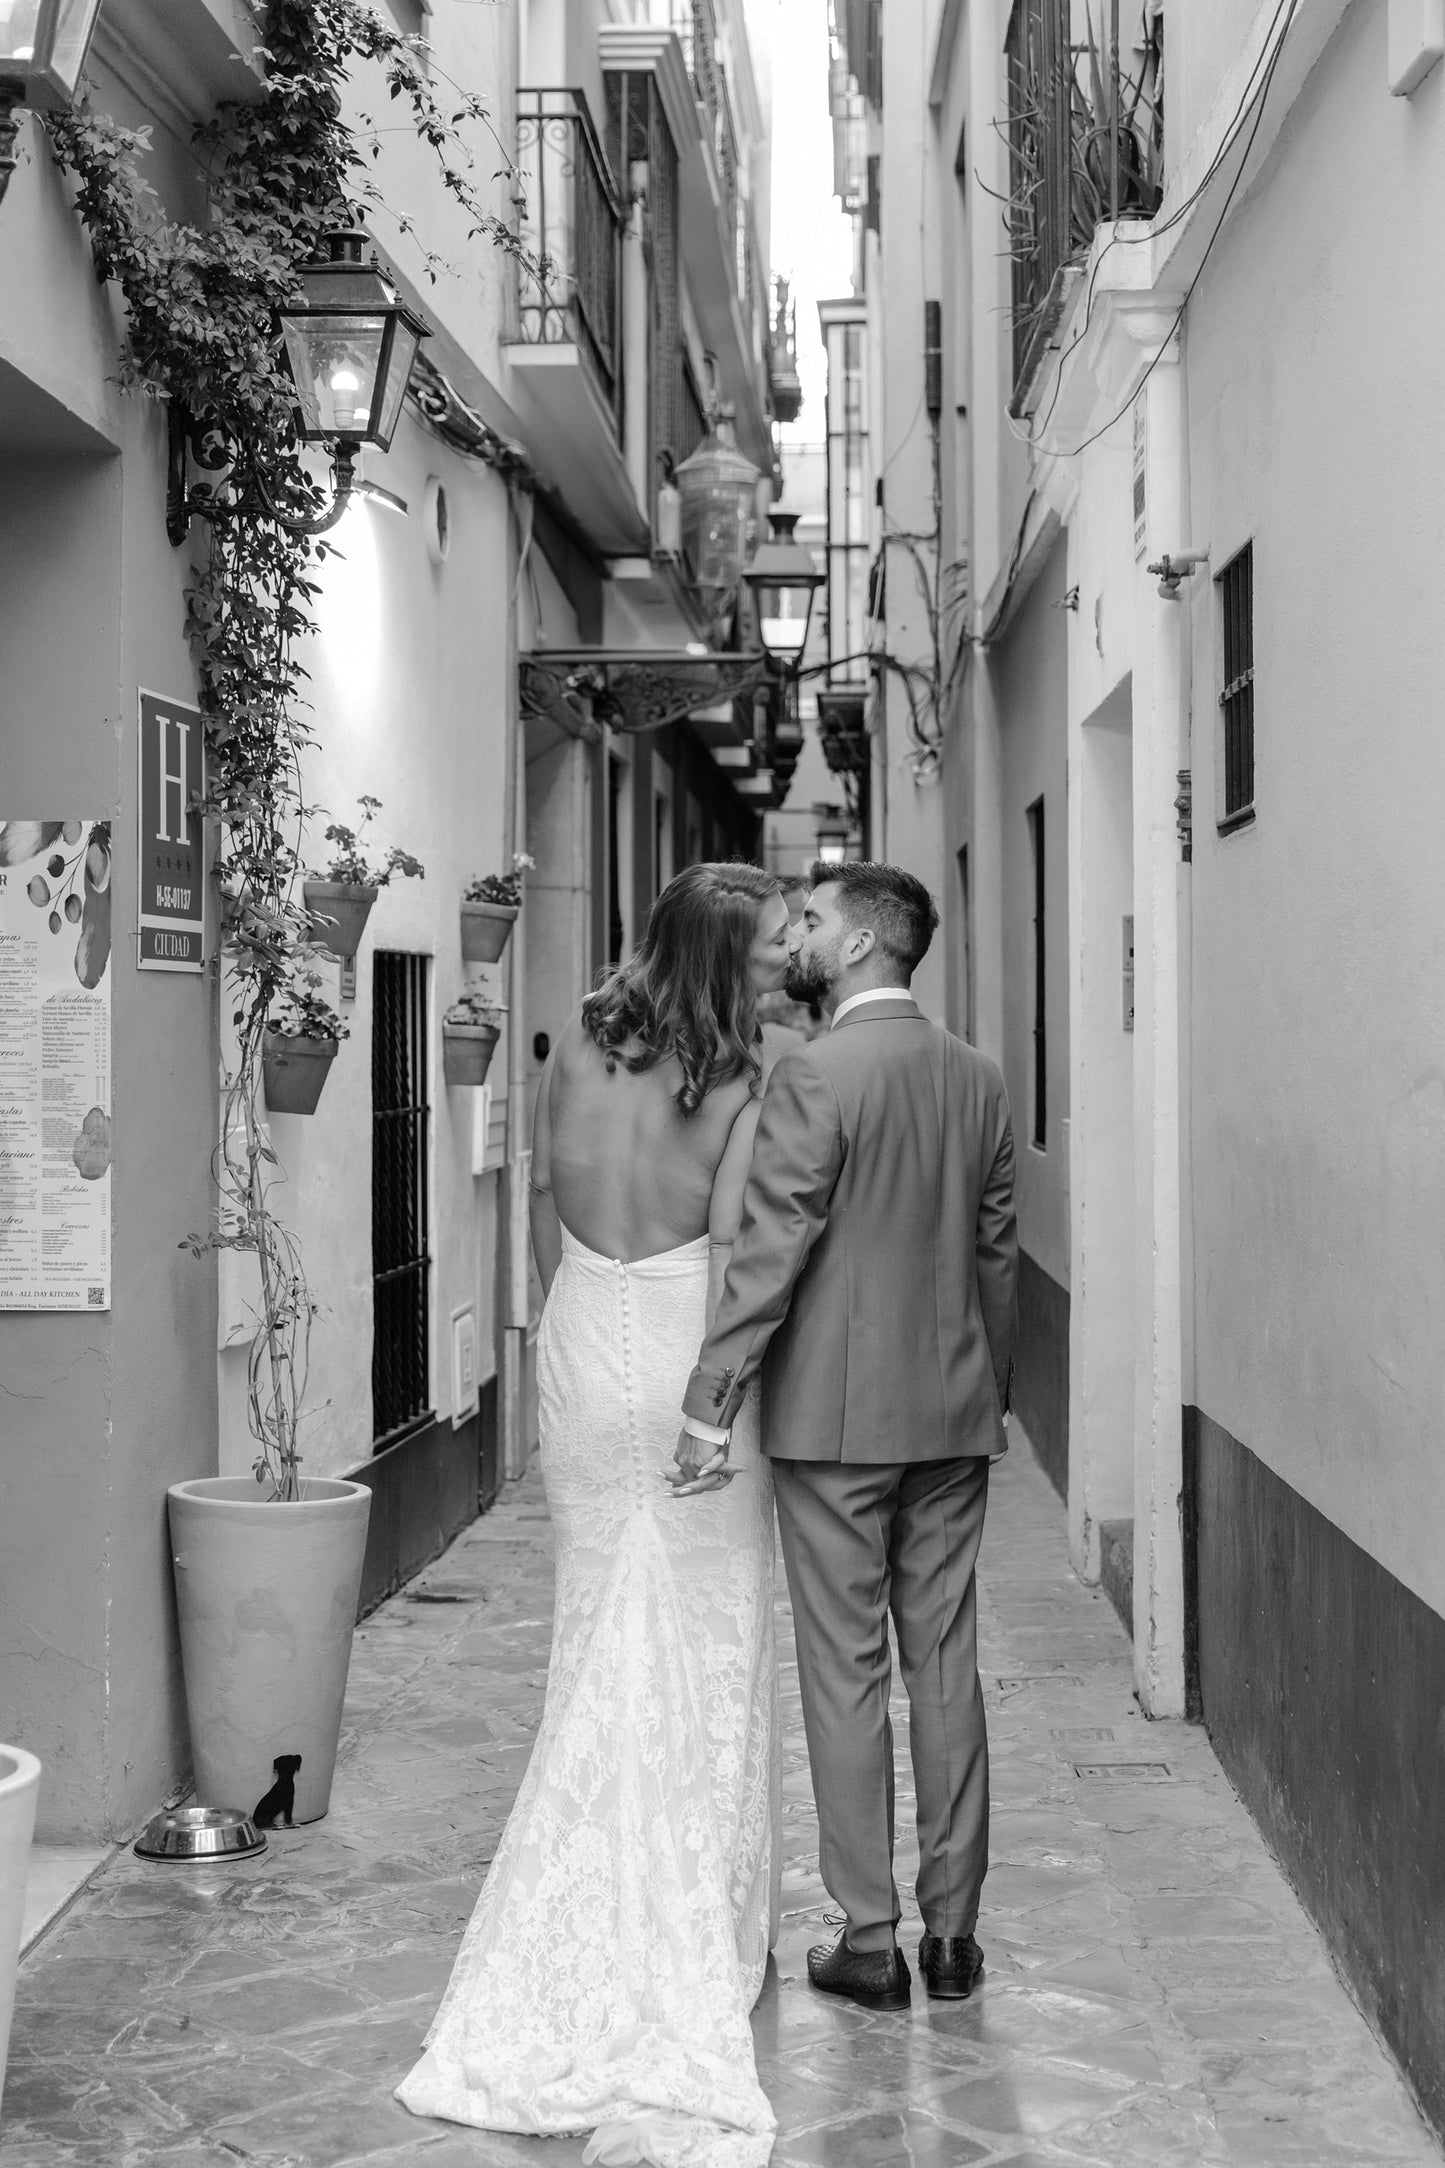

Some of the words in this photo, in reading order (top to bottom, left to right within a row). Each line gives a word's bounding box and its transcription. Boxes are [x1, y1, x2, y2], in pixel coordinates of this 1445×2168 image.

[155, 714, 191, 846] H
[156, 884, 191, 911] H-SE-01137
[0, 935, 21, 944] apas
[154, 932, 190, 958] CIUDAD
[0, 1106, 23, 1115] astas
[0, 1150, 35, 1158] tariano
